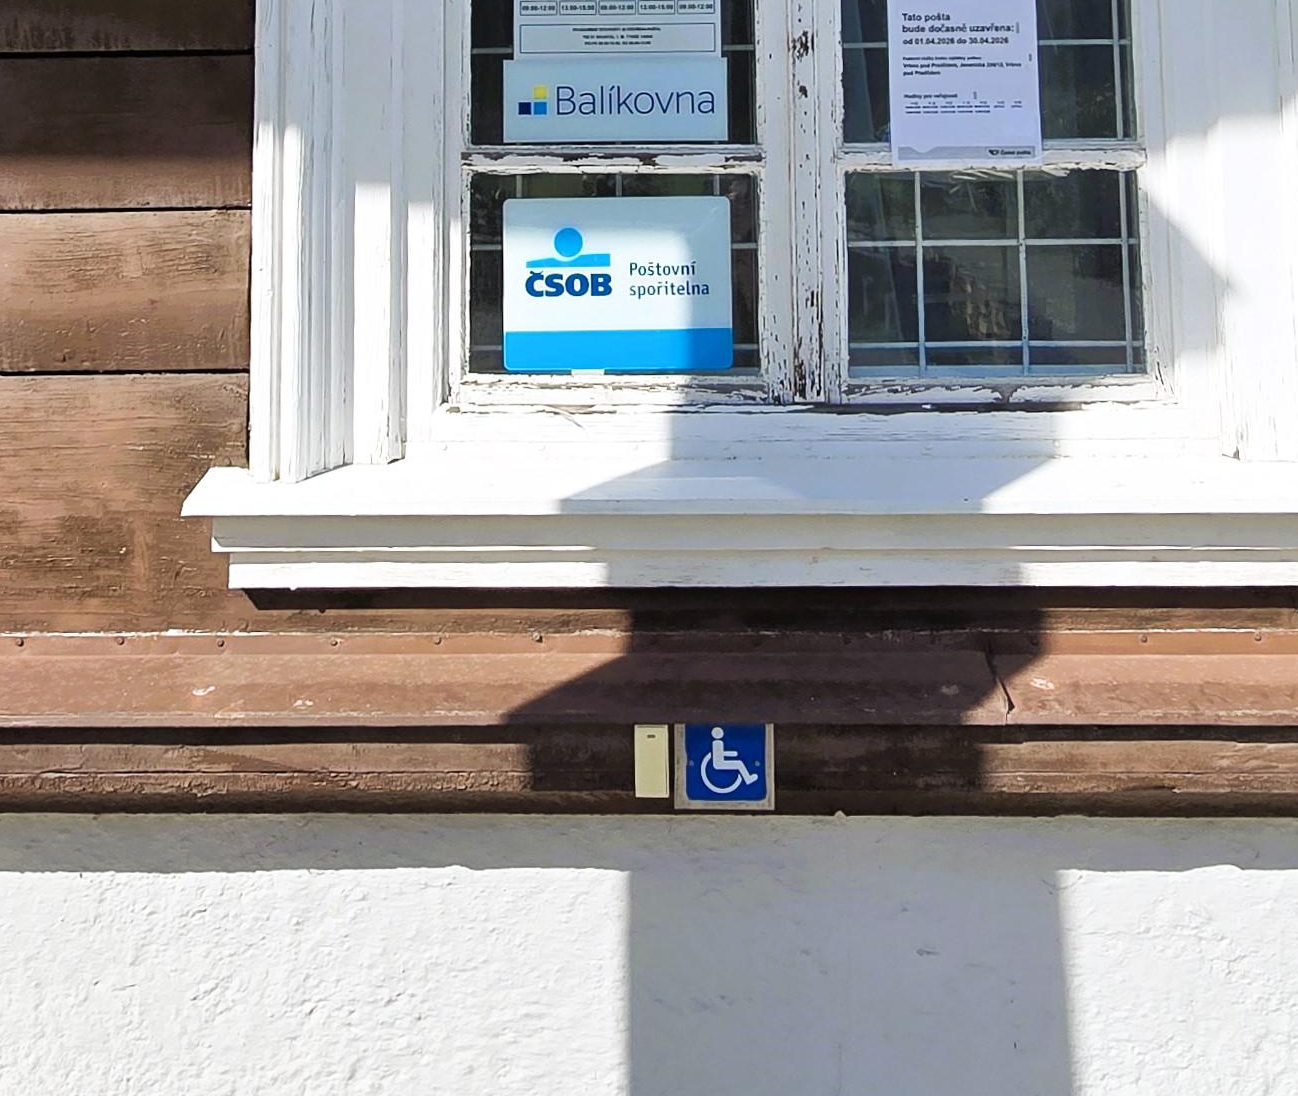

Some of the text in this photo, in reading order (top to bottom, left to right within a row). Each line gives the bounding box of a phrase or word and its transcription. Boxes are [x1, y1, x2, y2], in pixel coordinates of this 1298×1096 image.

[902, 13, 951, 22] Tato pošta
[902, 24, 925, 33] bude
[928, 23, 967, 32] dočasně
[903, 37, 913, 45] od
[956, 36, 967, 44] do
[556, 85, 715, 115] Balíkovna
[629, 261, 697, 276] Poštovní
[525, 270, 613, 298] ČSOB
[629, 281, 710, 300] spořitelna
